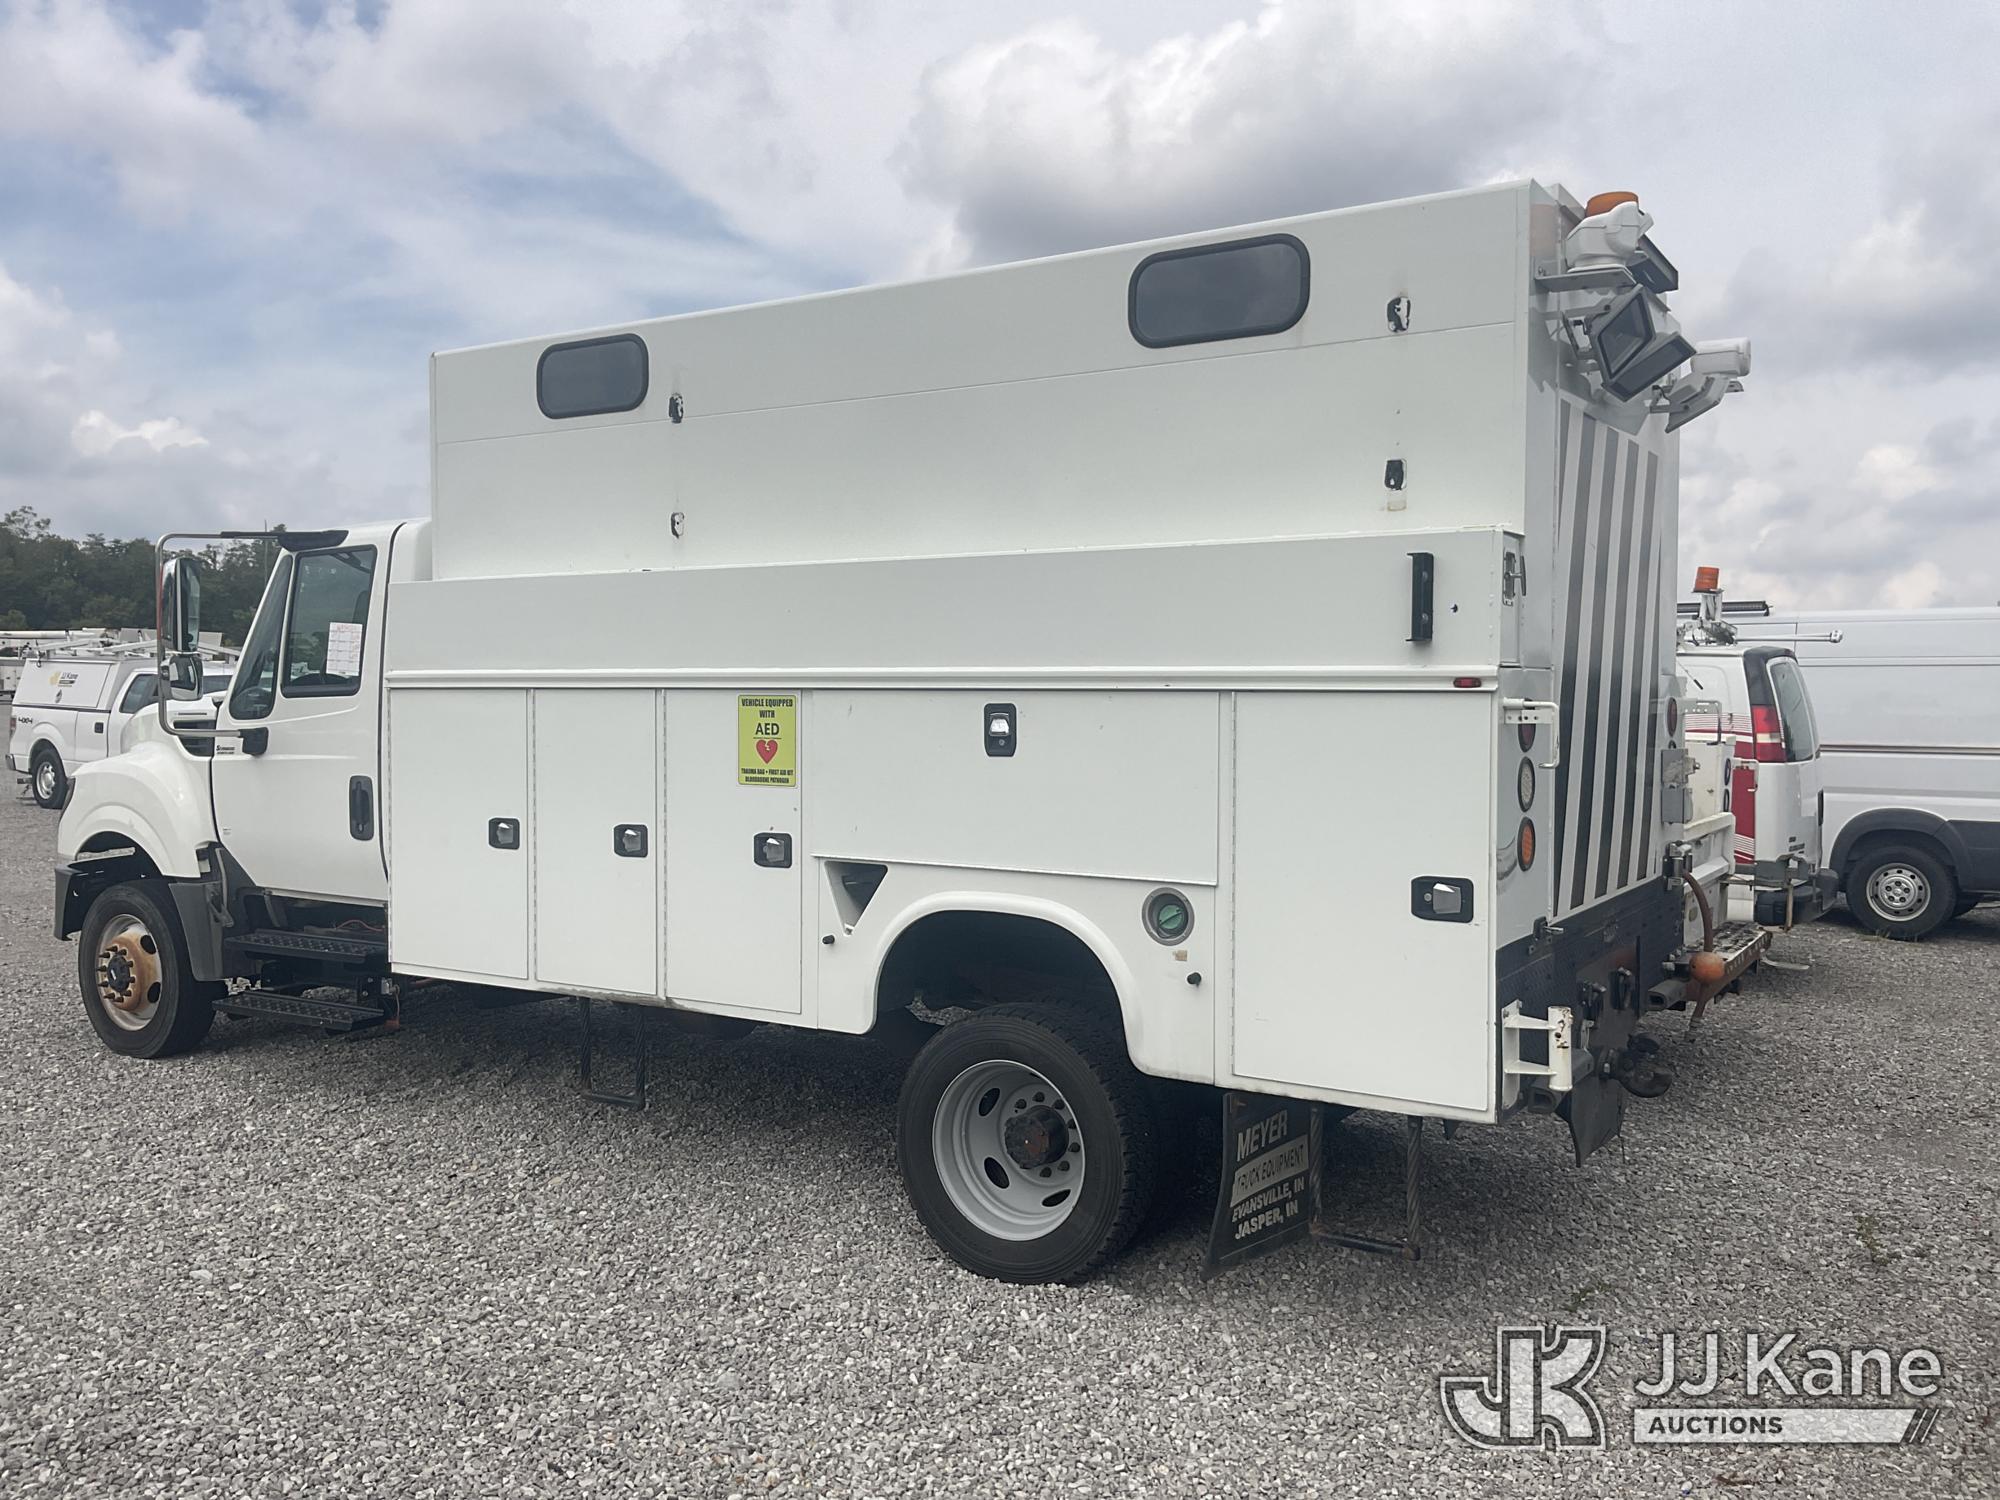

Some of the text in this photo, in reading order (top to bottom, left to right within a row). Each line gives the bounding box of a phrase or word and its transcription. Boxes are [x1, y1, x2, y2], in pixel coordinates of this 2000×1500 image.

[742, 698, 793, 708] VEHICLE EQUIPPED
[760, 710, 775, 718] WITH
[755, 722, 780, 736] AED
[1236, 1110, 1288, 1162] MEYER
[1237, 1145, 1304, 1196] TRUCK EQUIPMENT
[1232, 1176, 1304, 1223] EVANSVILLE, IN
[1234, 1200, 1299, 1240] JASPER, IN
